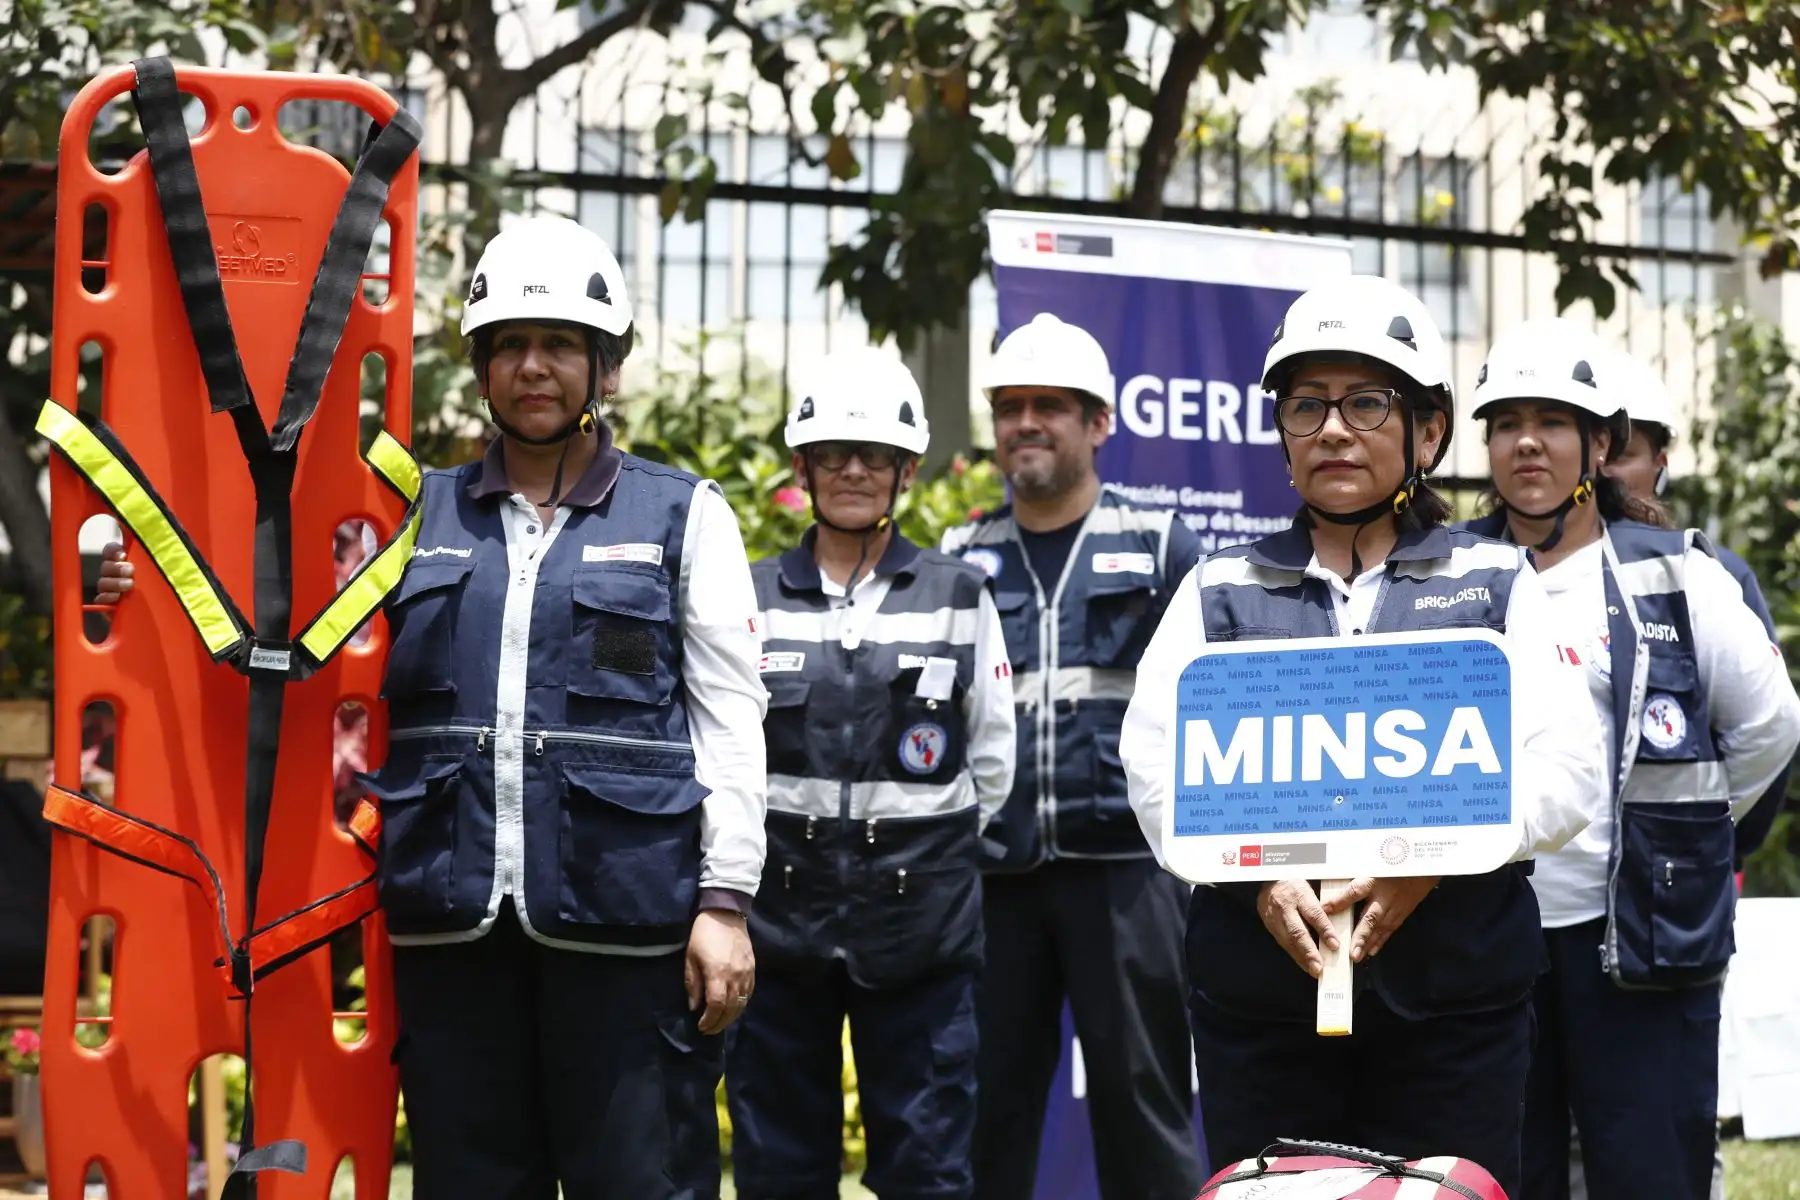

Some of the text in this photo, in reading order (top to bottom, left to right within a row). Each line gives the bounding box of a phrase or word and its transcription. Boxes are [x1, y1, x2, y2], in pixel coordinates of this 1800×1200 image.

[523, 285, 549, 296] PETZL
[1318, 320, 1345, 332] PETZL
[1415, 587, 1491, 610] BRIGADISTA
[1193, 643, 1498, 668] MINSA MINSA MINSA MINSA MINSA MINSA
[1180, 657, 1508, 682] MINSA MINSA MINSA MINSA MINSA MINSA MINSA
[1192, 673, 1498, 697] MINSA MINSA MINSA MINSA MINSA MINSA
[1179, 688, 1508, 713] MINSA MINSA MINSA MINSA MINSA MINSA MINSA
[1184, 706, 1502, 786] MINSA
[1176, 781, 1508, 802] MINSA MINSA MINSA MINSA MINSA MINSA MINSA
[1189, 797, 1498, 817] MINSA MINSA MINSA MINSA MINSA MINSA
[1175, 812, 1508, 834] MINSA MINSA MINSA MINSA MINSA MINSA MINSA
[1242, 851, 1260, 860] PERÚ
